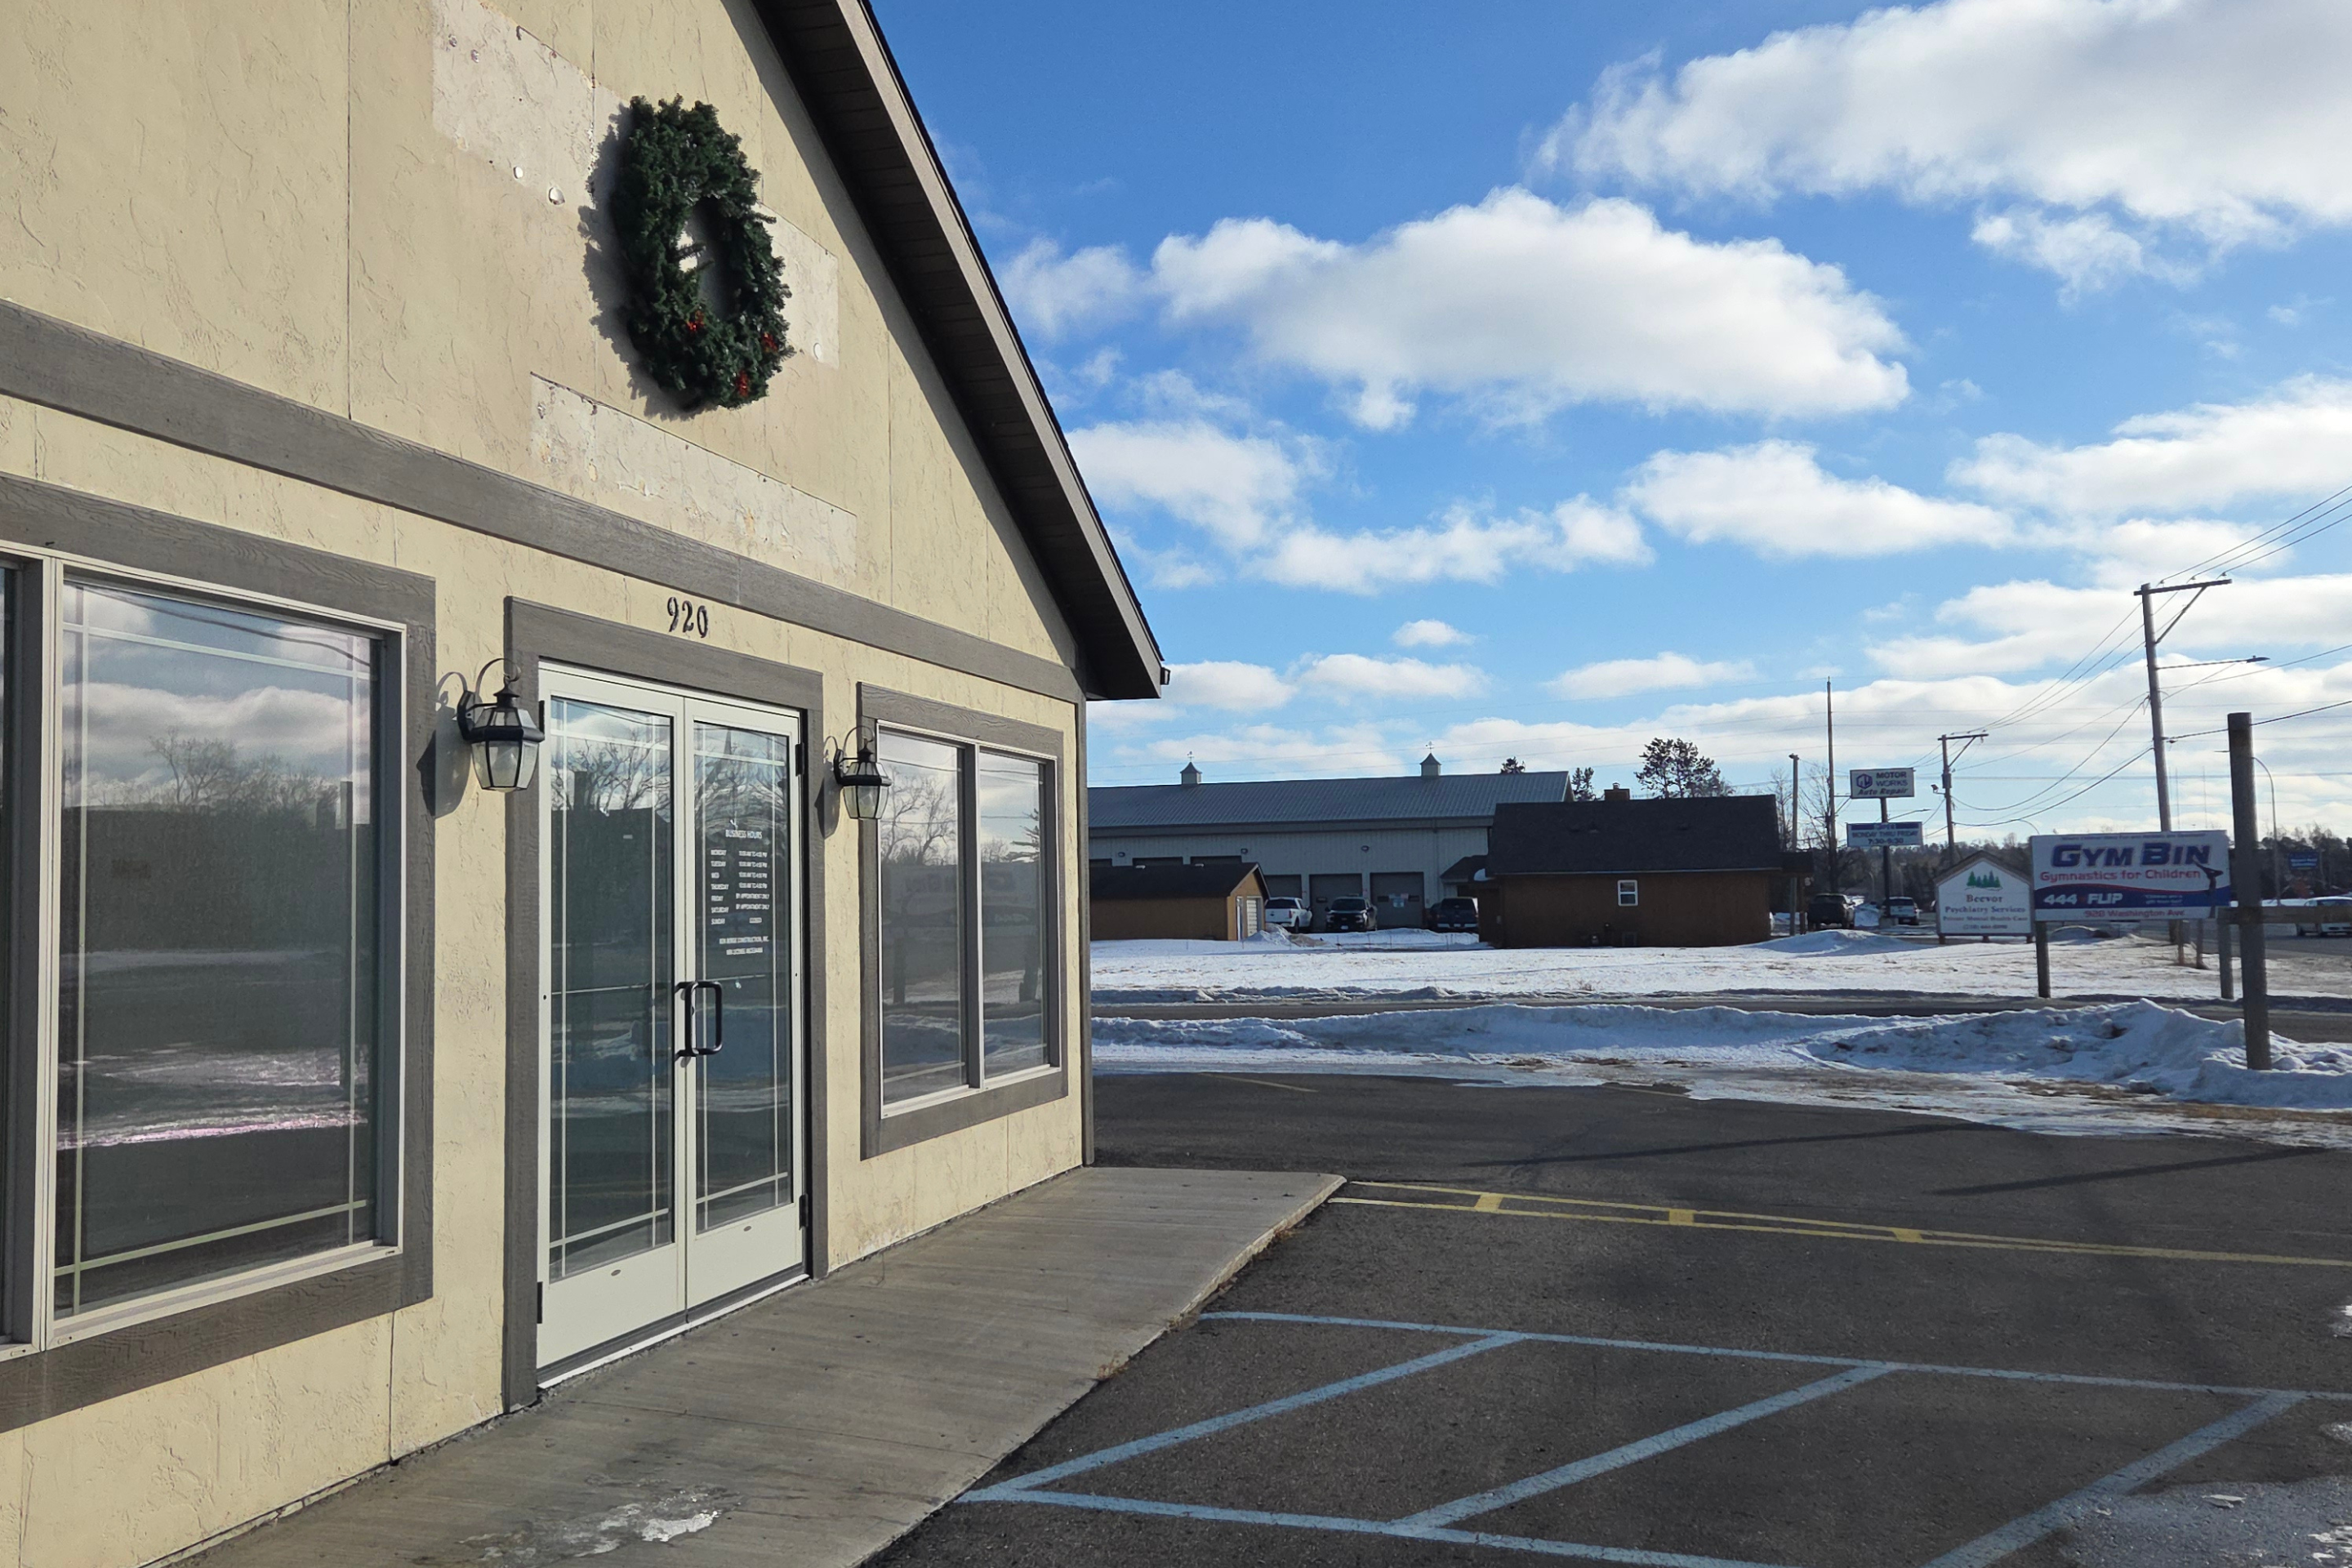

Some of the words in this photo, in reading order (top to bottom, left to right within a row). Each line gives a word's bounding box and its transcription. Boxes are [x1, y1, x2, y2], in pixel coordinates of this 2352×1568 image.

[667, 596, 708, 638] 920
[725, 829, 746, 839] BUSINESS
[747, 831, 763, 840] HOURS
[2051, 844, 2134, 867] GYM
[2141, 842, 2211, 866] BIN
[2040, 871, 2117, 882] Gymnastics
[2121, 871, 2141, 880] for
[2145, 870, 2200, 879] Children
[2043, 894, 2078, 905] 444
[2087, 893, 2123, 904] FLIP
[1944, 906, 1988, 914] Psychiatry
[2108, 909, 2164, 918] Washington
